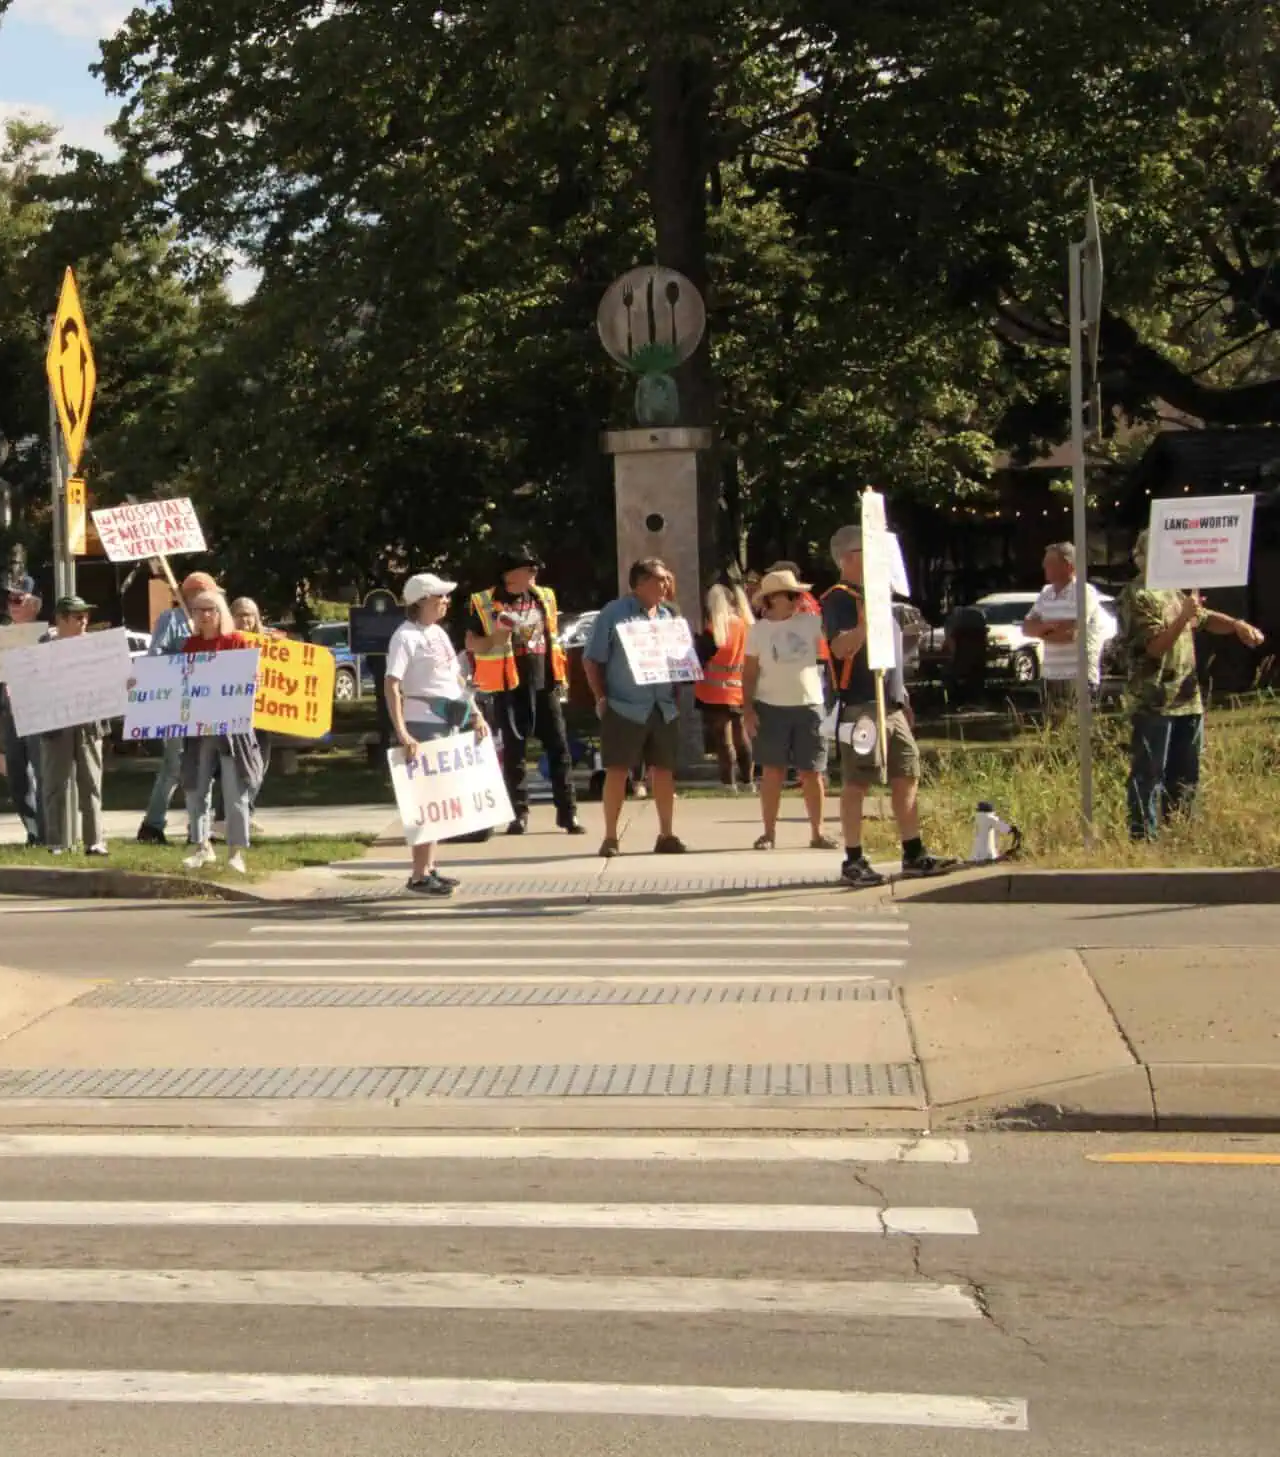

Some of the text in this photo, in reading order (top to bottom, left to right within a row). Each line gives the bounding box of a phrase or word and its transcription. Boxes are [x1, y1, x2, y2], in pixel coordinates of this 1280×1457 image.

[118, 515, 196, 540] MEDICARE
[167, 651, 217, 665] TRUMP
[260, 638, 290, 662] ice
[127, 682, 255, 703] BULLY AND LIAR
[264, 667, 298, 696] lity
[254, 693, 299, 719] dom
[131, 726, 150, 738] OK
[156, 723, 189, 737] WITH
[405, 743, 485, 780] PLEASE
[415, 787, 497, 827] JOIN US
